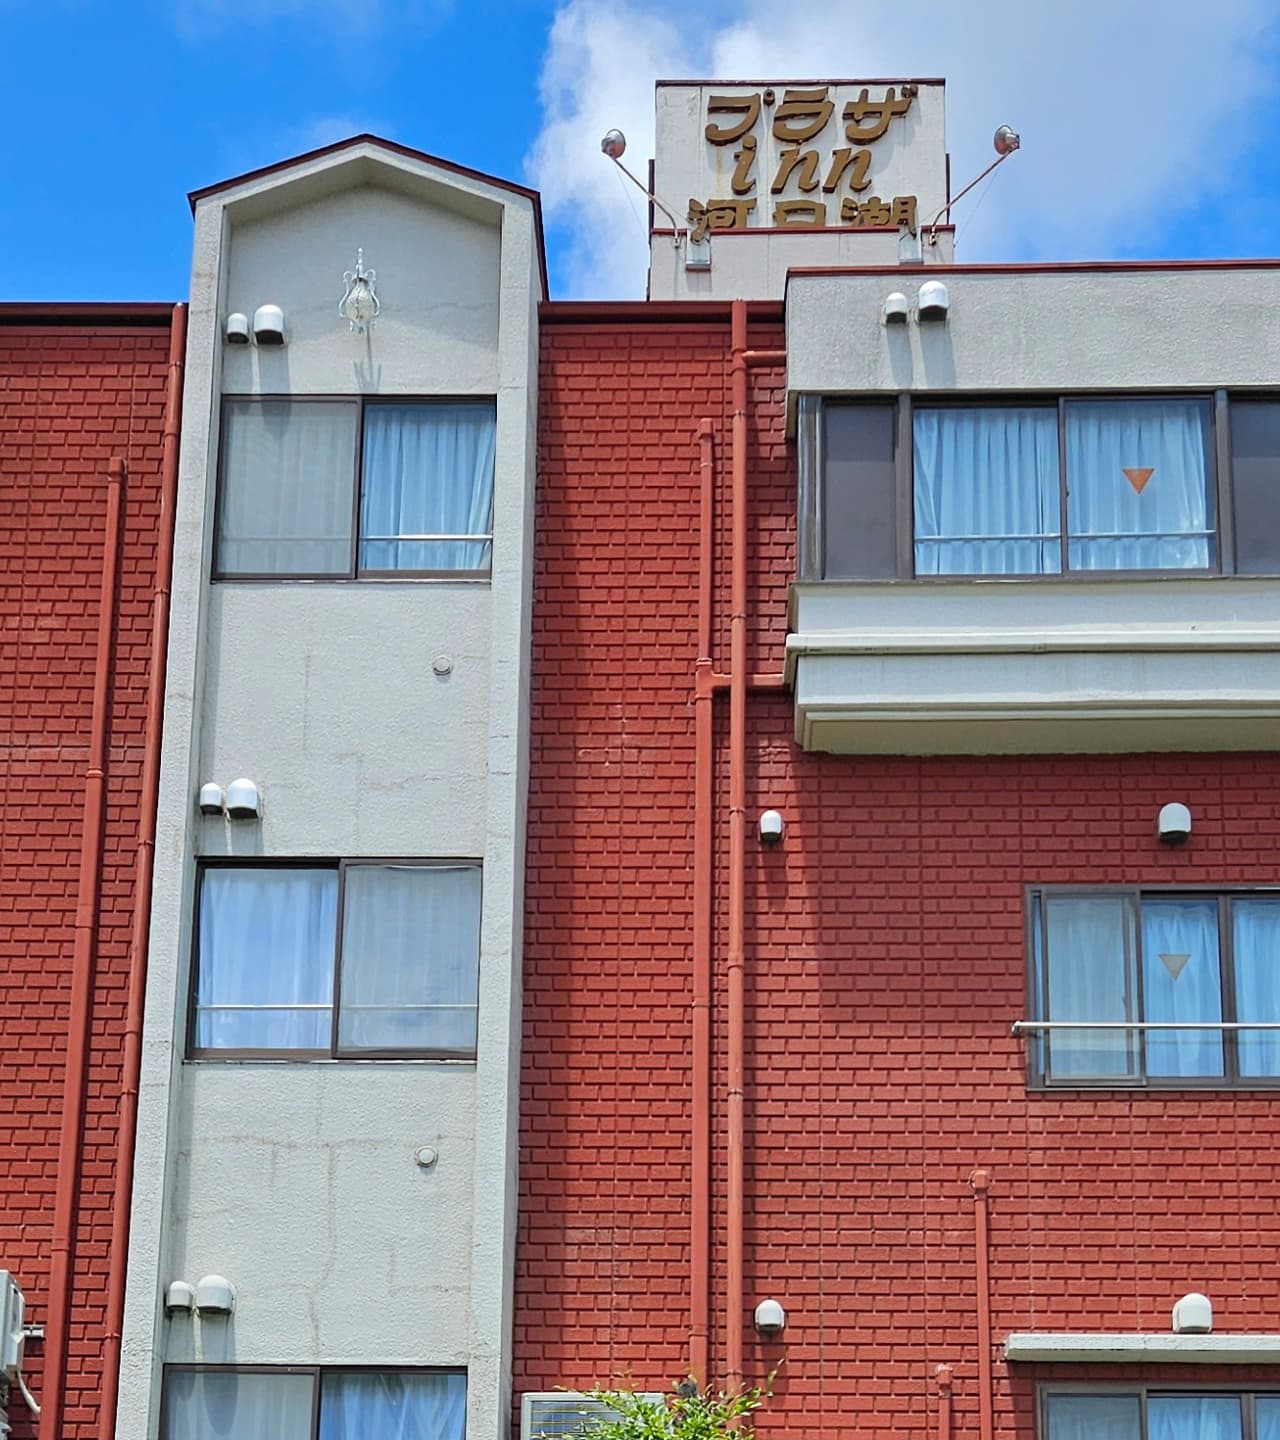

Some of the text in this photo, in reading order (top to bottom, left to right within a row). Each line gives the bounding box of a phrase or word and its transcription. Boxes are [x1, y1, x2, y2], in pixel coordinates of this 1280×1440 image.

[705, 86, 919, 146] プラザ
[731, 134, 872, 195] inn
